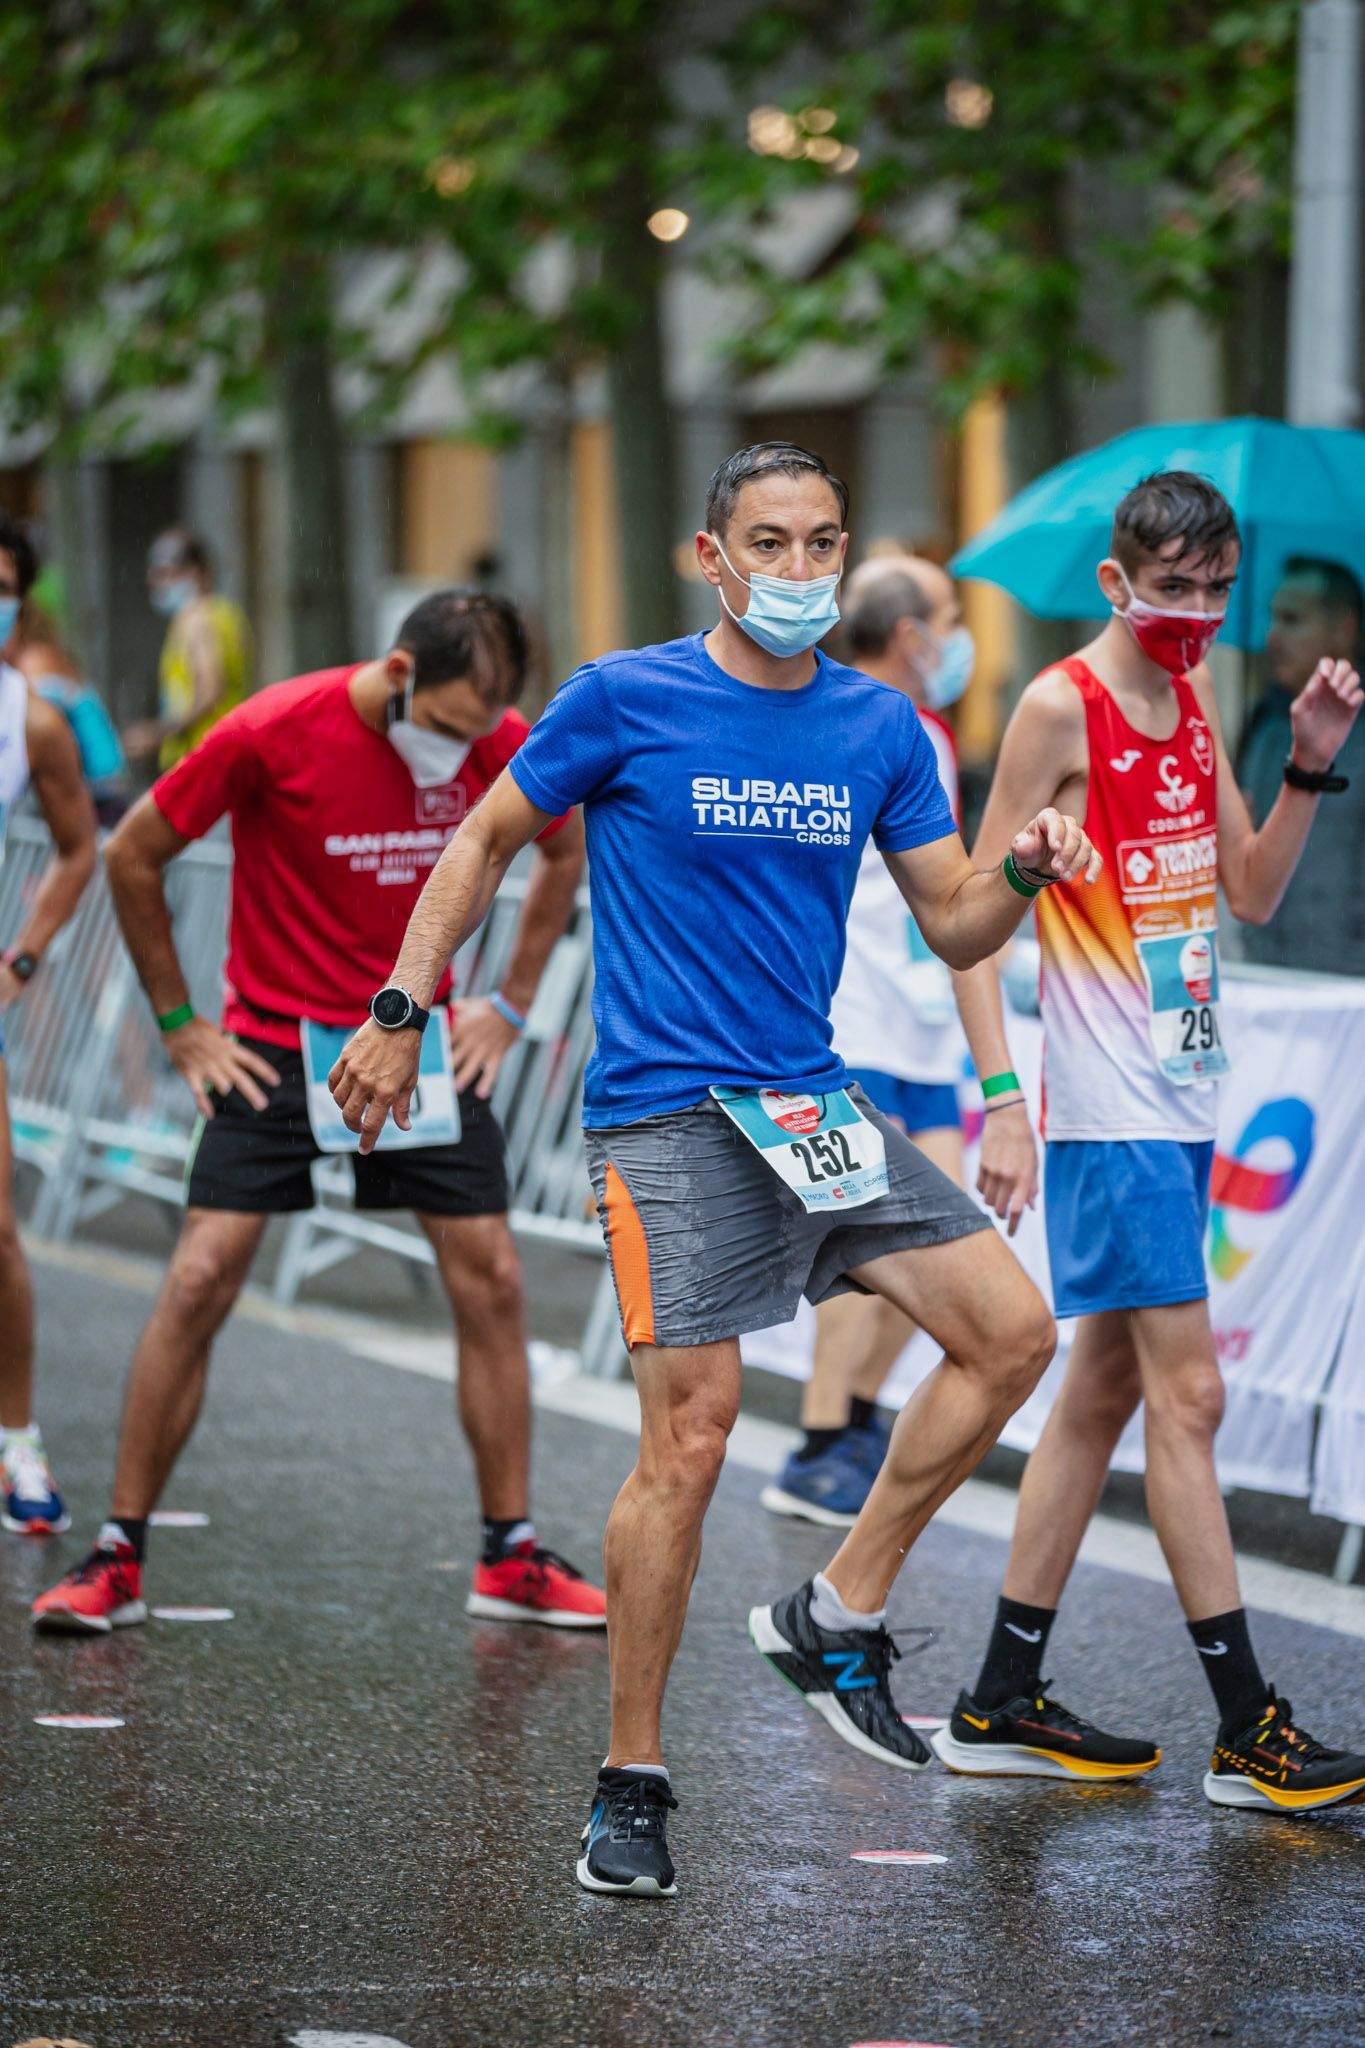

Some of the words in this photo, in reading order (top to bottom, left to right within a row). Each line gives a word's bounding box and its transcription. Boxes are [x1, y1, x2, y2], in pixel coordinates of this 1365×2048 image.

[691, 777, 850, 808] SUBARU
[692, 803, 851, 833] TRIATLON
[796, 831, 850, 846] CROSS
[791, 1129, 862, 1184] 252
